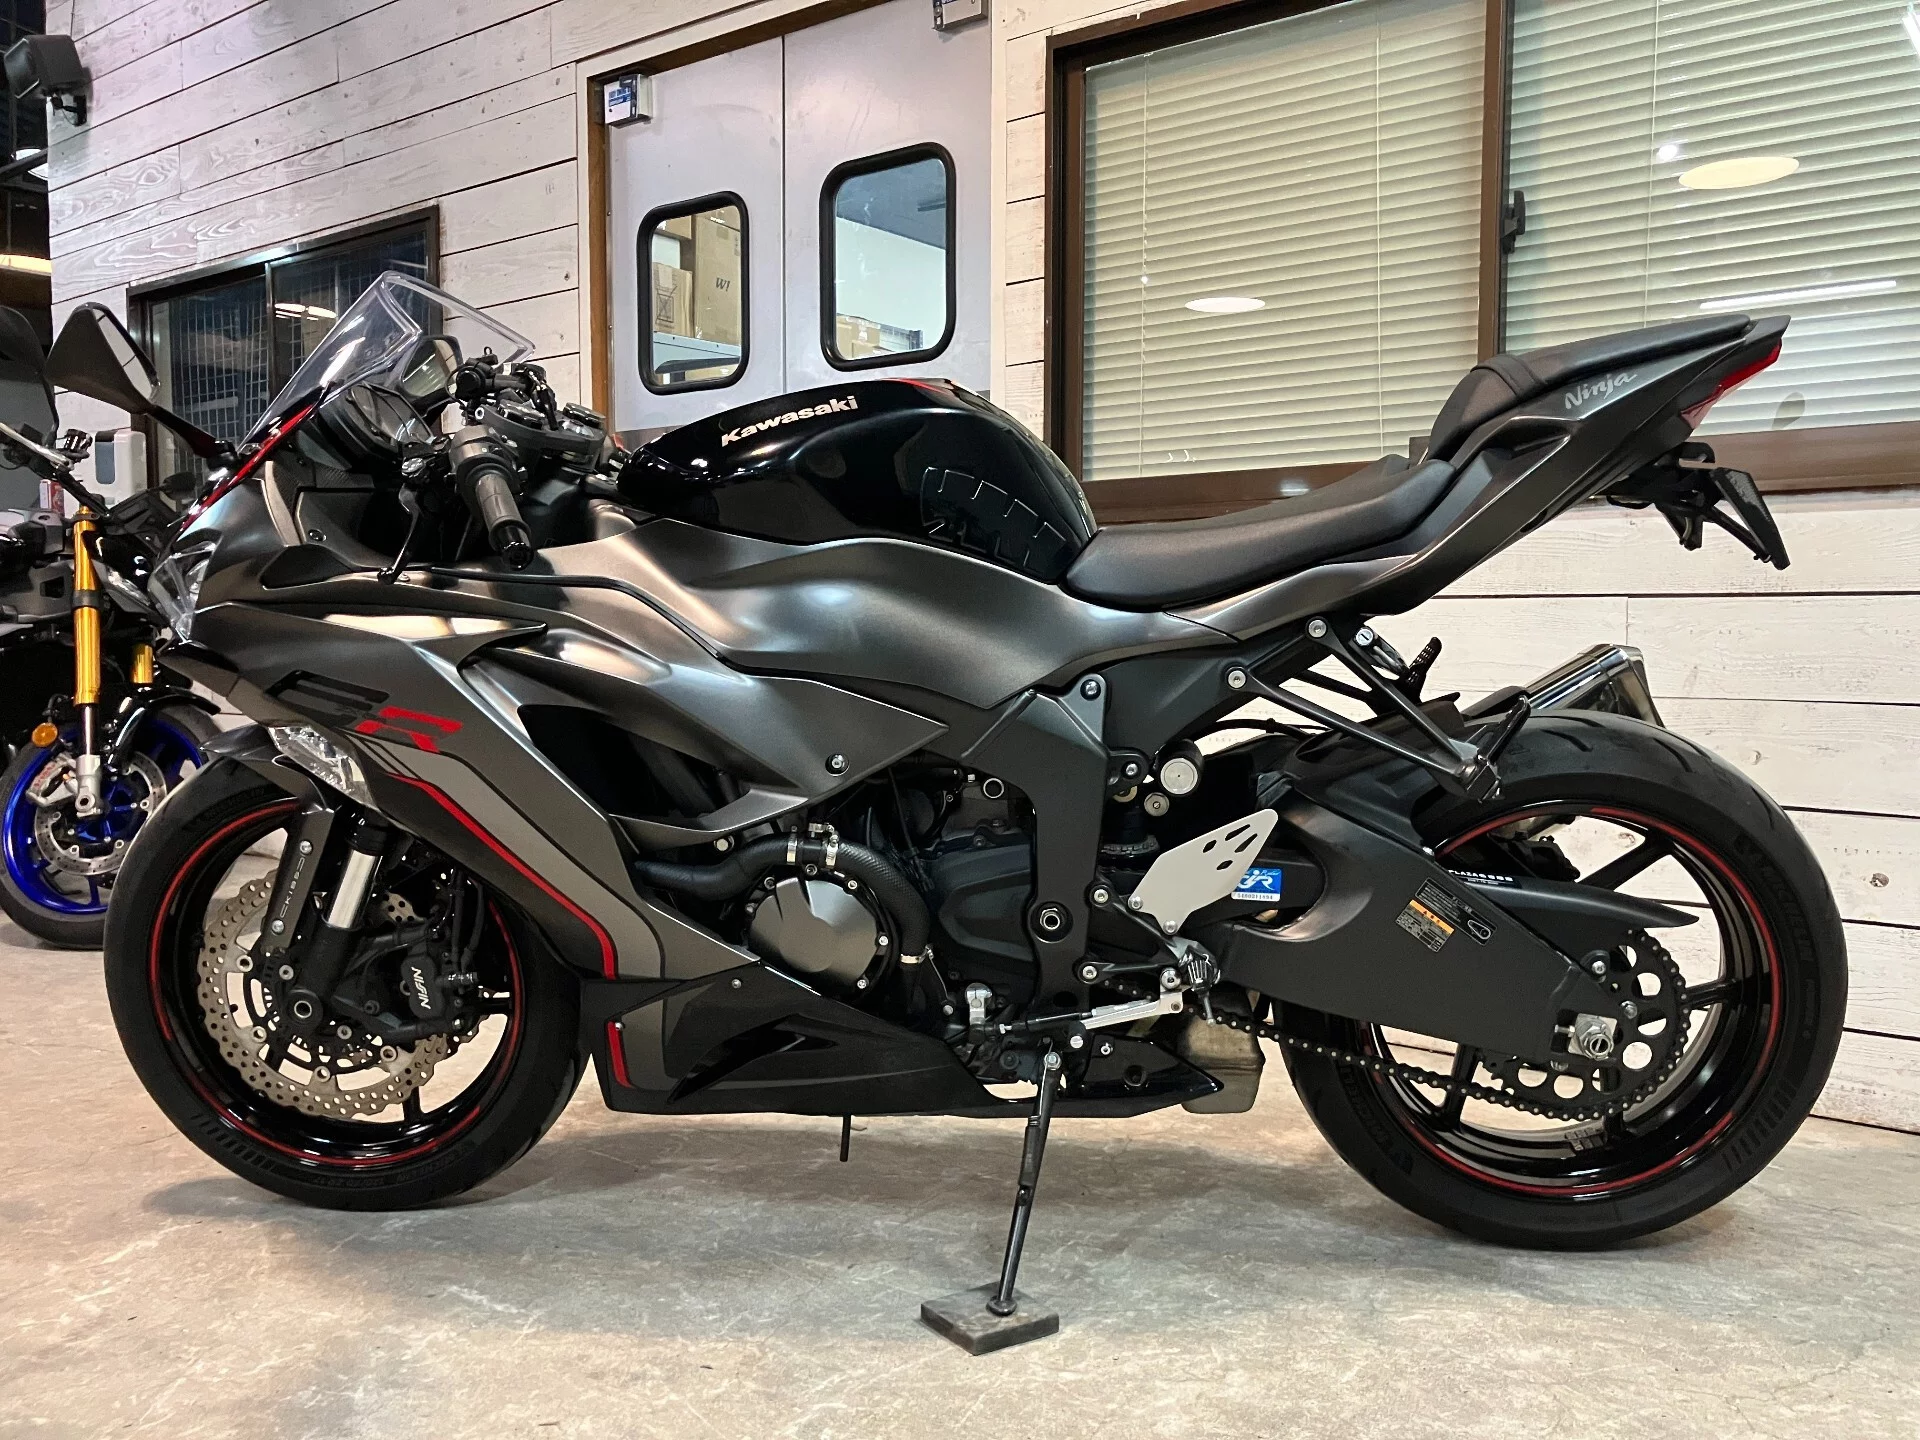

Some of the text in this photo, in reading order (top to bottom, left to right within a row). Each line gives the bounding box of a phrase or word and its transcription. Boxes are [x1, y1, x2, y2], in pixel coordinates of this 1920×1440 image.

[1564, 373, 1638, 410] Ninja
[721, 395, 859, 447] Kawasaki
[411, 966, 432, 1010] NISSIN
